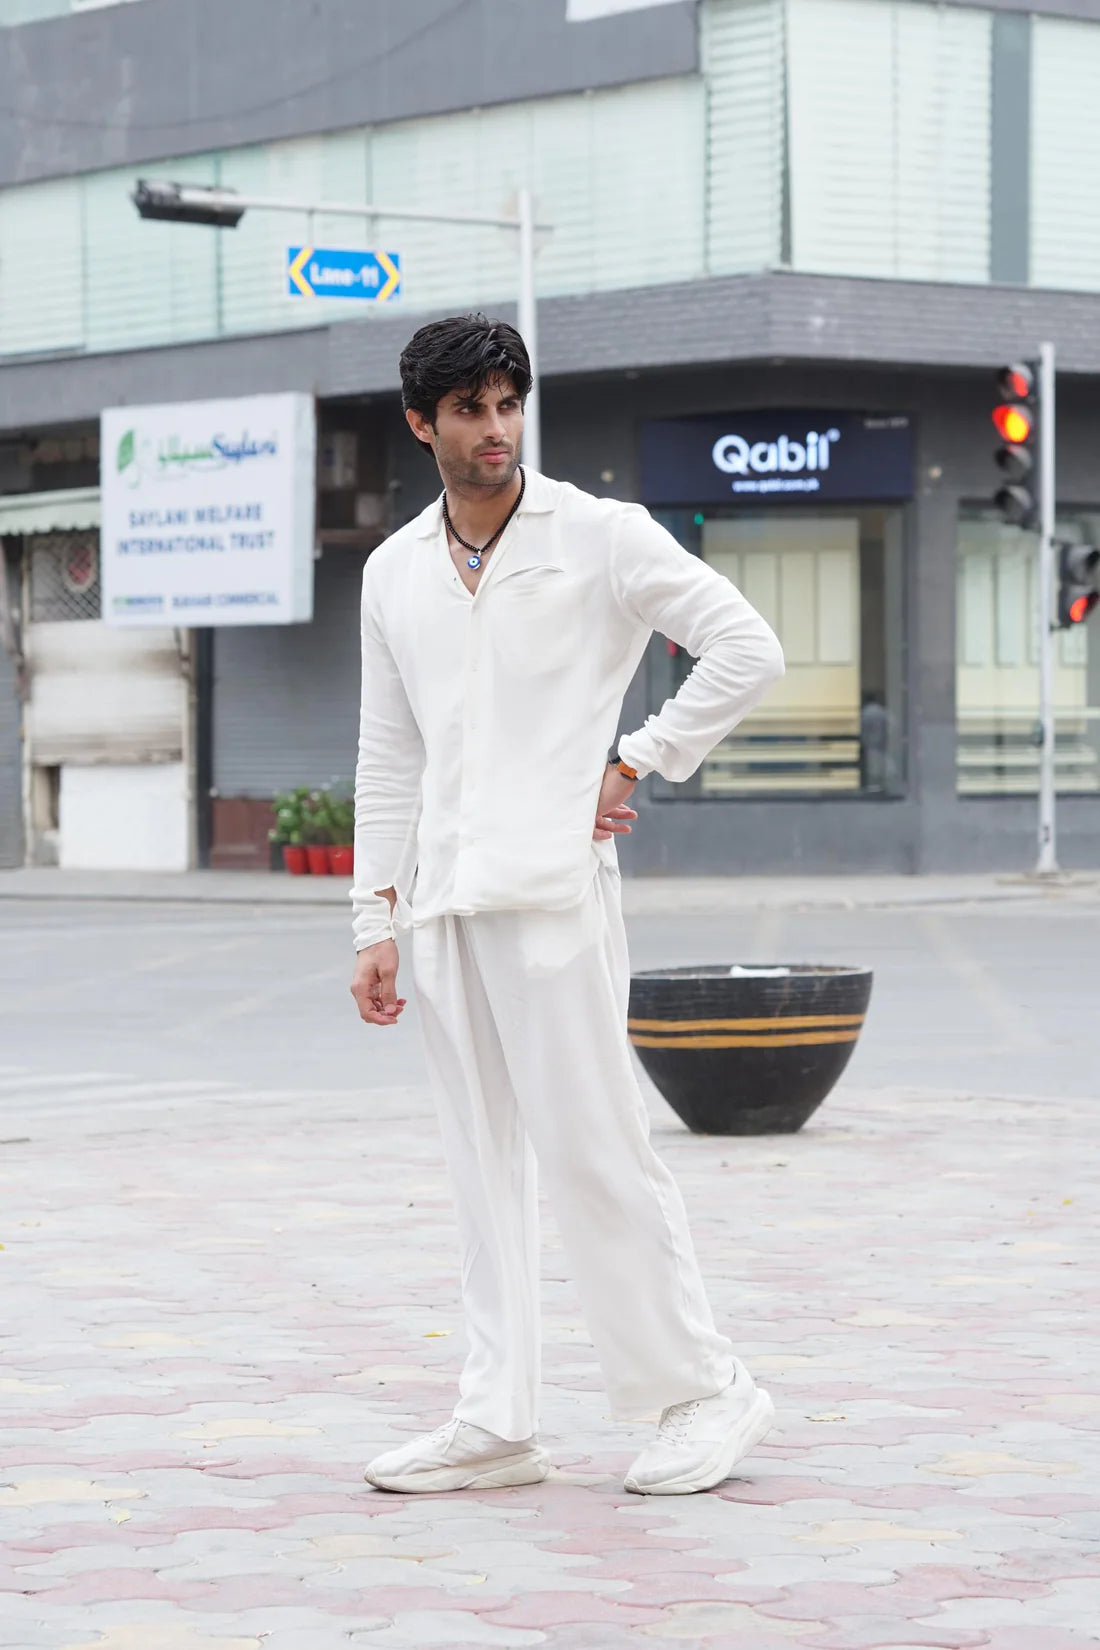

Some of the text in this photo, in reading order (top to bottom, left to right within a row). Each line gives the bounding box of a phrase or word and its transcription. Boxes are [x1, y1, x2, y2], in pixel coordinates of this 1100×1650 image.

[309, 261, 379, 288] Lane-11
[712, 430, 832, 475] Qabil
[128, 503, 263, 528] SAYLANI WELFARE
[116, 530, 275, 555] INTERNATIONAL TRUST
